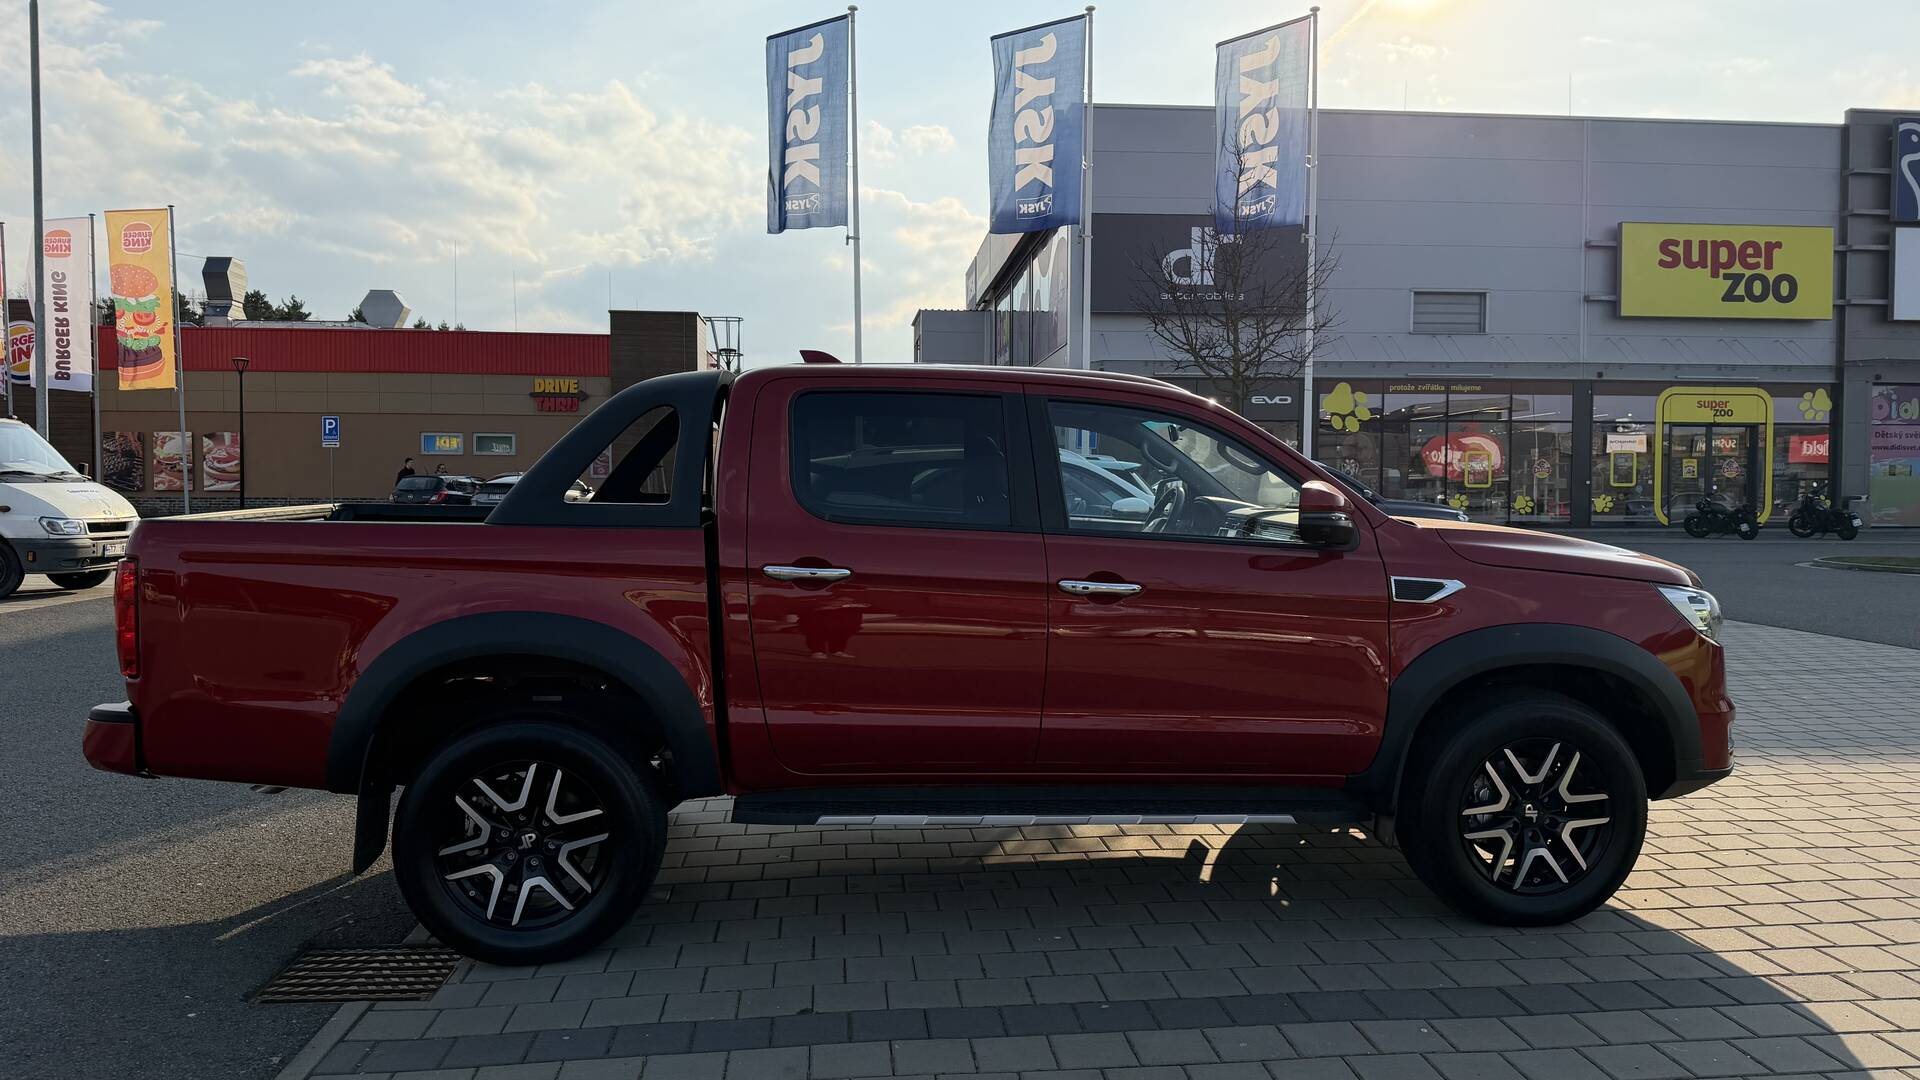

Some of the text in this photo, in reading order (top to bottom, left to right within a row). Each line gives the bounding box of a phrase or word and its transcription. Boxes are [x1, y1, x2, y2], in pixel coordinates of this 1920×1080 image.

[1657, 238, 1783, 279] super
[534, 377, 579, 393] DRIVE
[536, 396, 579, 412] THRU
[1251, 395, 1292, 404] EVO
[1696, 399, 1730, 411] super
[325, 418, 336, 434] P
